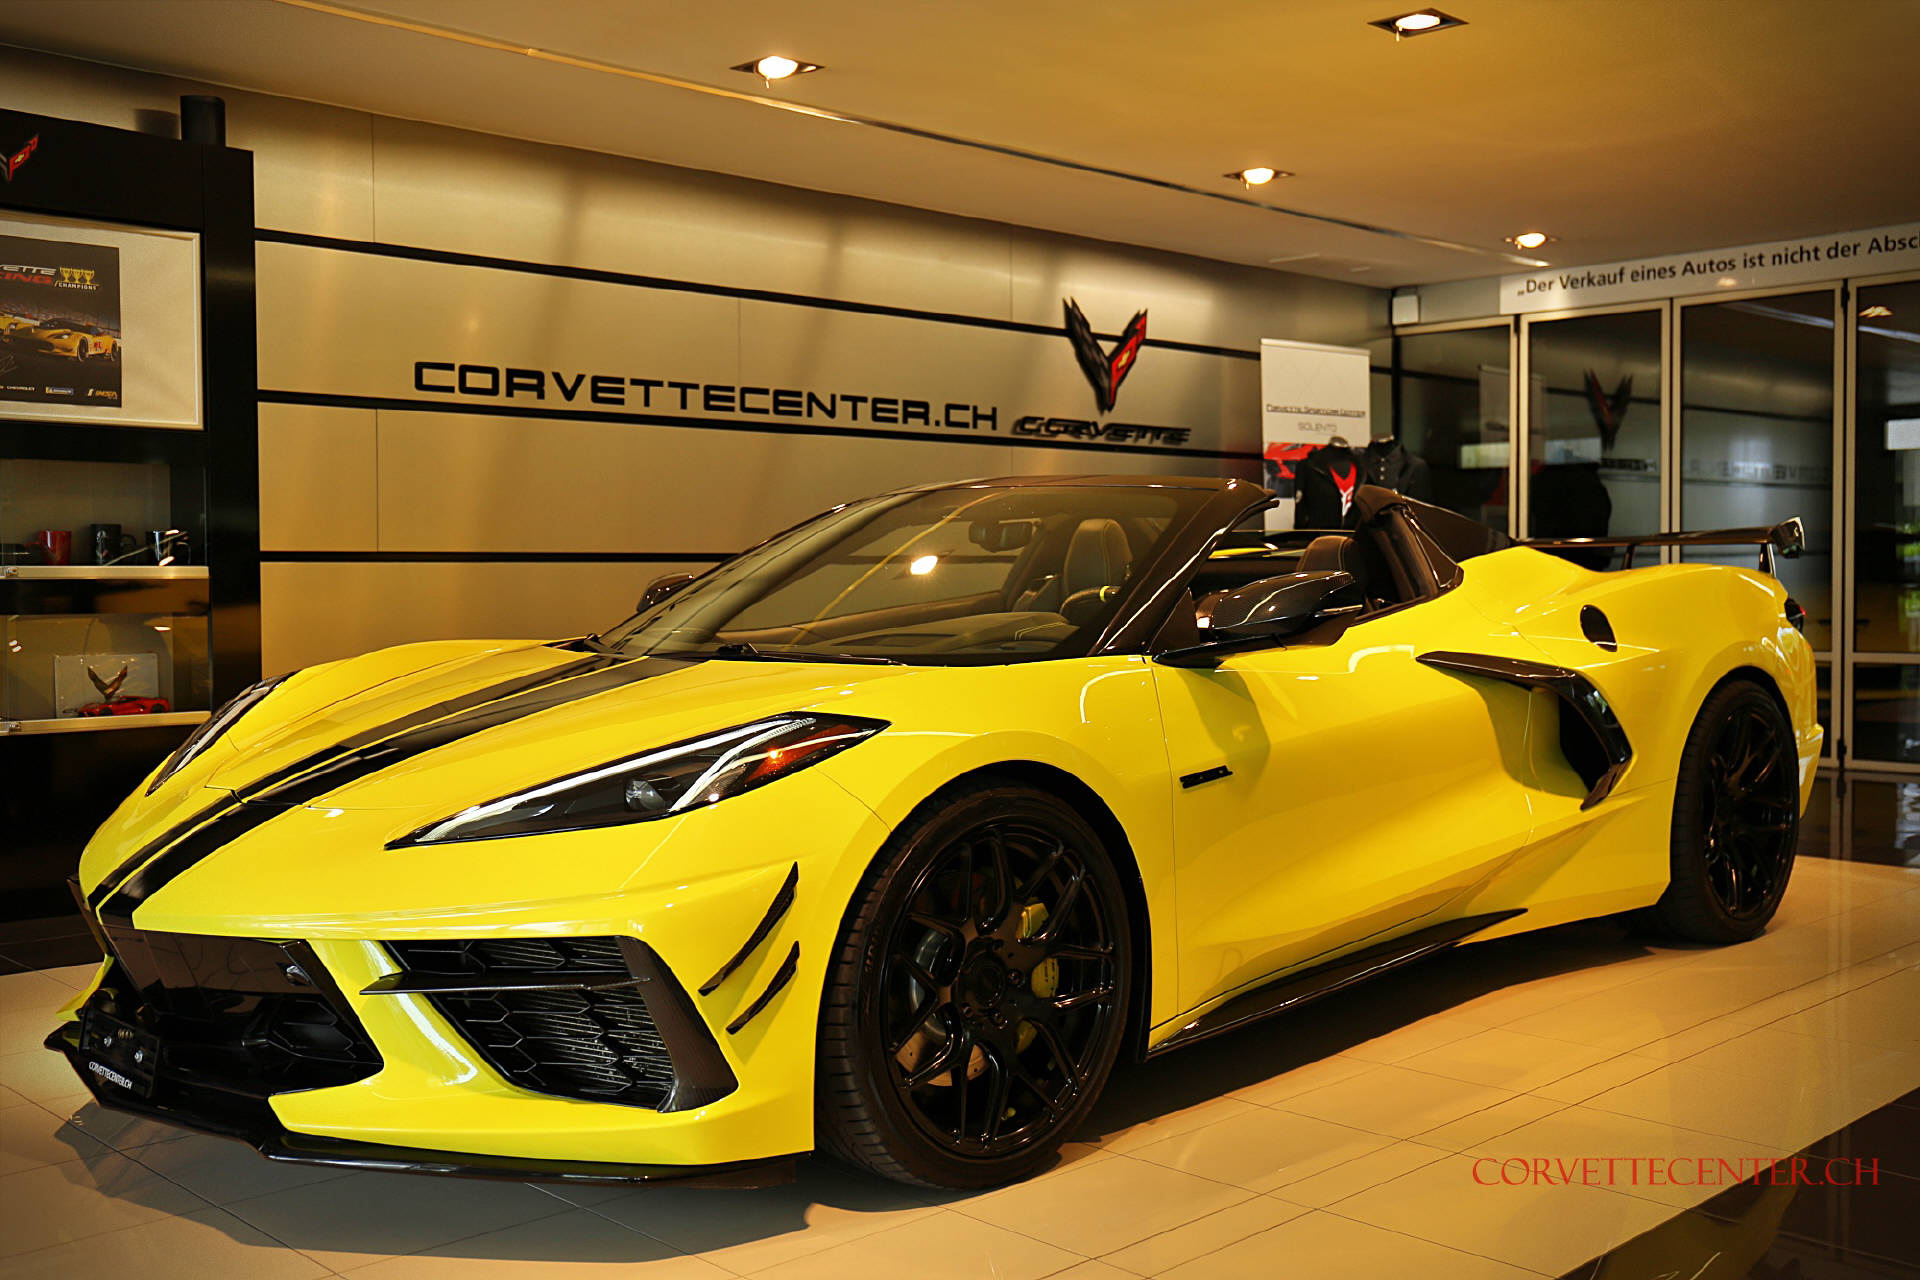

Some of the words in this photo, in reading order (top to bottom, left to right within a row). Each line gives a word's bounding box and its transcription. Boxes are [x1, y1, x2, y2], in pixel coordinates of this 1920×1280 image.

[0, 264, 56, 276] ETTE
[1559, 266, 1625, 290] Verkauf
[1630, 264, 1677, 282] eines
[1681, 257, 1737, 277] Autos
[1743, 252, 1765, 269] ist
[1771, 244, 1820, 266] nicht
[1826, 241, 1861, 260] der
[1867, 231, 1920, 255] Absc
[58, 282, 98, 291] CHAMPIONS
[414, 361, 998, 431] CORVETTECENTER.CH
[1015, 416, 1191, 443] CORVETTE
